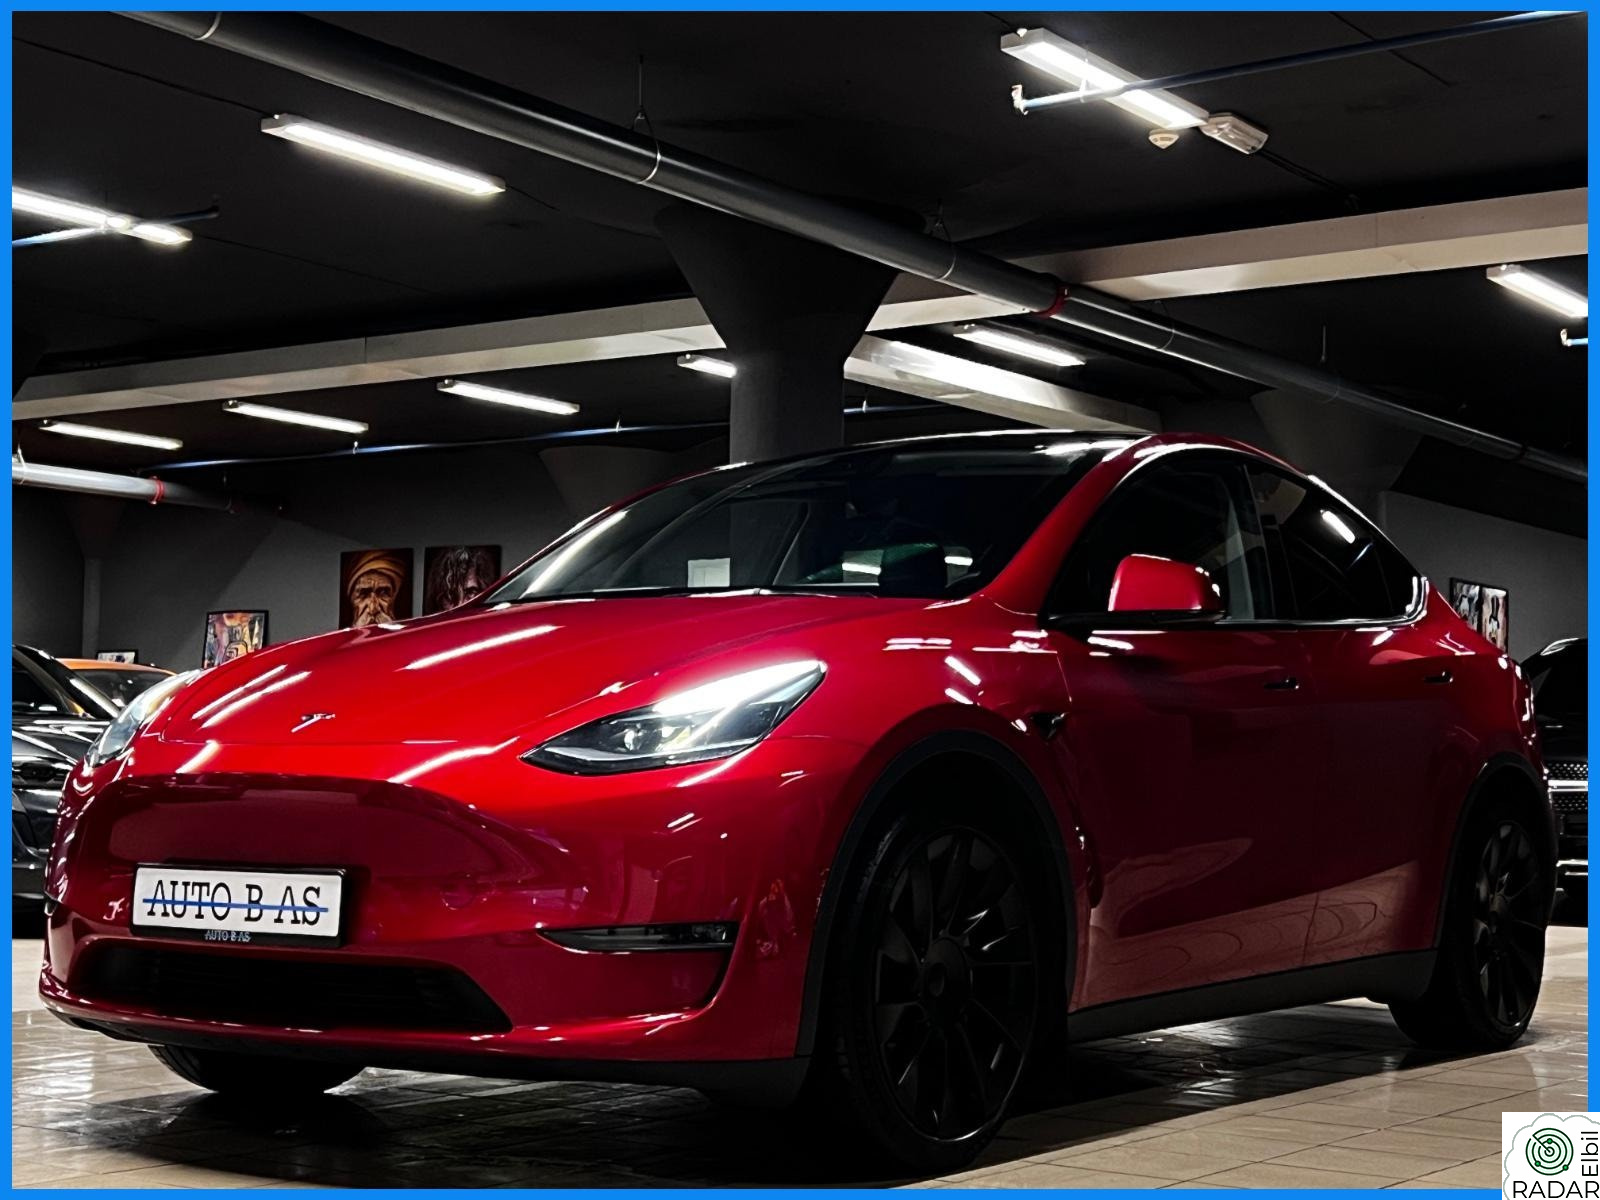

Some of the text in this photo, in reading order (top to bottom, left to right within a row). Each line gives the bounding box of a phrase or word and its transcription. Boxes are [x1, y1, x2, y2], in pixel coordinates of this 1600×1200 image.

[147, 880, 321, 926] AUTO B AS
[205, 930, 229, 941] AUTO
